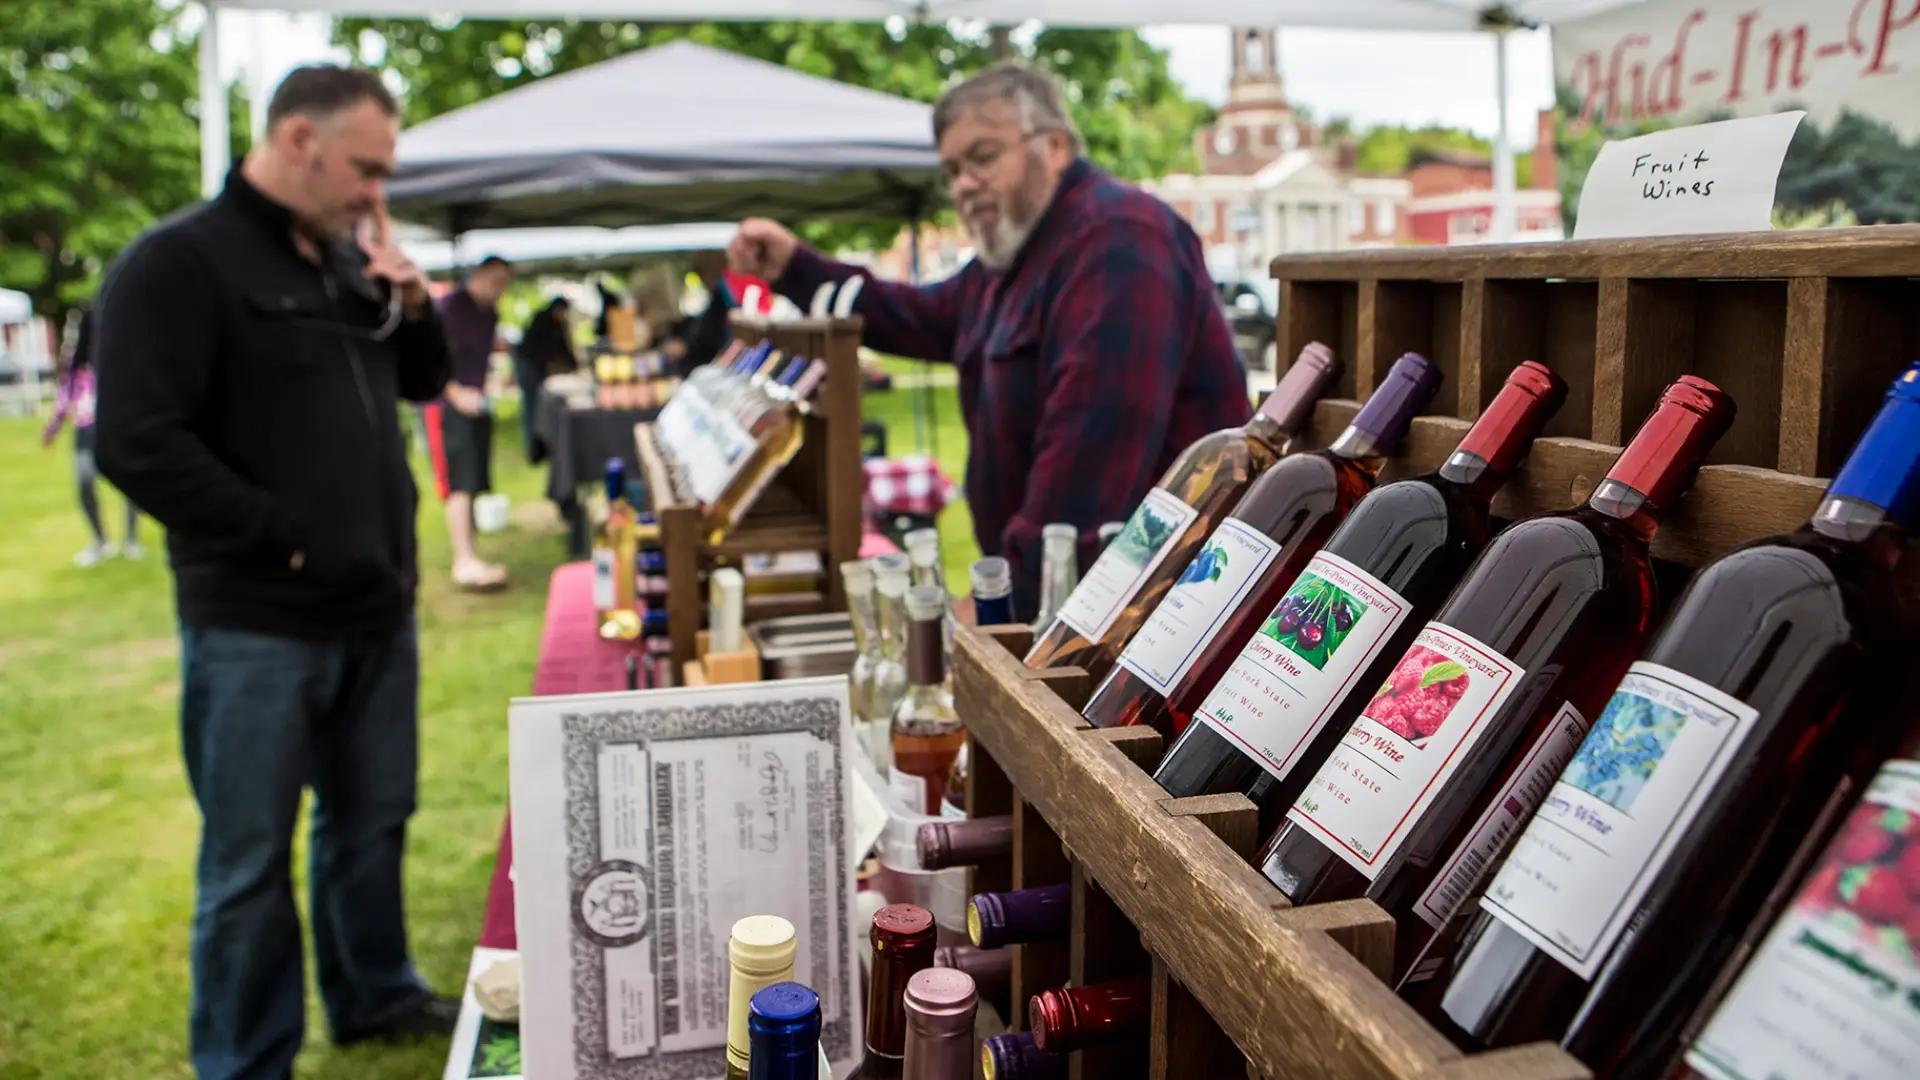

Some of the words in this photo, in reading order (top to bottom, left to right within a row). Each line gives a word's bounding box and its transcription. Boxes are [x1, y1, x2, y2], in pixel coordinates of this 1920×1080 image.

[1632, 149, 1709, 178] Fruit
[1643, 179, 1715, 200] Wines
[1352, 580, 1396, 614] Vineyard
[1273, 653, 1302, 677] Wine
[1453, 645, 1504, 679] Vineyard
[1241, 670, 1261, 688] York
[1263, 685, 1291, 710] State
[1240, 696, 1264, 718] Wine
[1262, 747, 1274, 759] 750
[1373, 736, 1405, 763] Wine
[1327, 781, 1352, 805] Wine
[1351, 768, 1382, 794] State
